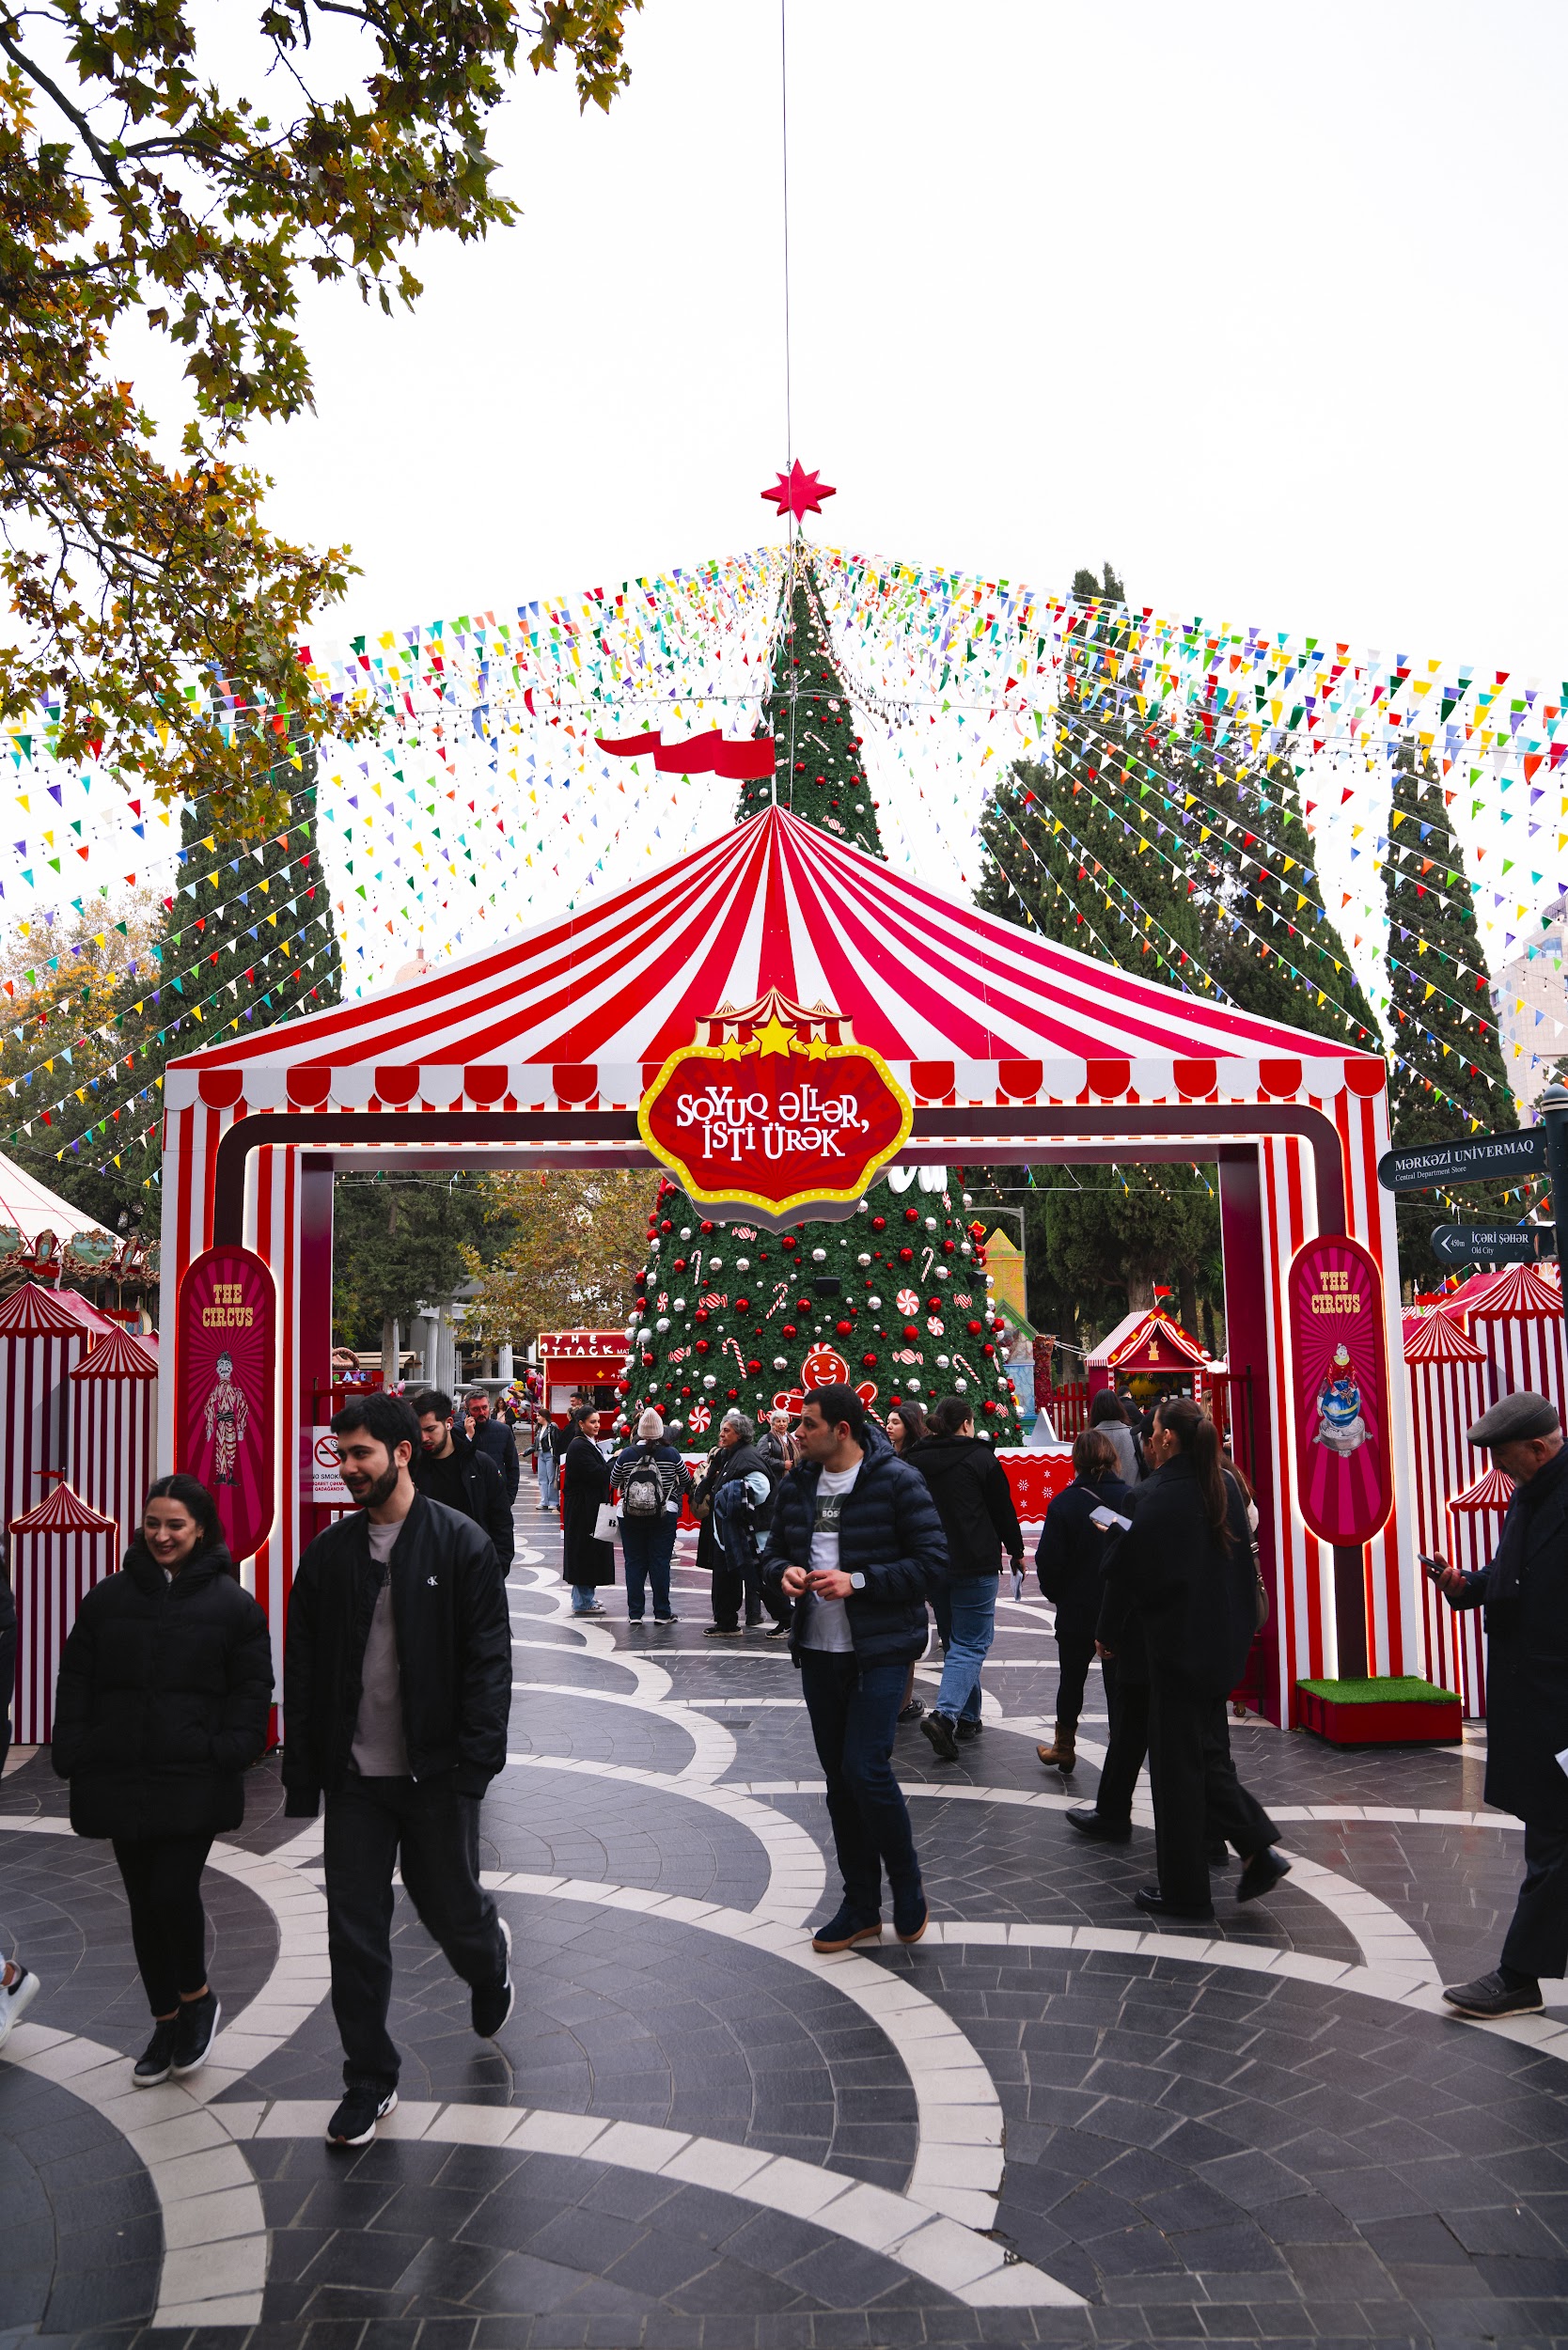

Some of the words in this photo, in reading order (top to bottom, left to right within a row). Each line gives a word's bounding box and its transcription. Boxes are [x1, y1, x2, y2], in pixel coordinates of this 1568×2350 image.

[677, 1086, 769, 1127] SOYUQ
[702, 1120, 756, 1162] İSTİ
[761, 1121, 846, 1160] ÜRƏK
[1395, 1151, 1450, 1171] MƏRKƏZİ
[1454, 1140, 1534, 1162] UNİVERMAQ
[1395, 1171, 1416, 1182] Central
[1417, 1167, 1450, 1179] Department
[1450, 1166, 1467, 1174] Store
[1450, 1239, 1466, 1247] 450m
[1471, 1230, 1497, 1246] İÇƏRİ
[1498, 1233, 1529, 1246] ŞƏHƏR
[1471, 1246, 1482, 1255] Old
[1482, 1246, 1495, 1256] City
[1320, 1271, 1348, 1292] THE
[213, 1284, 242, 1304] THE
[1311, 1294, 1360, 1314] CIRCUS
[202, 1308, 253, 1327] CIRCUS
[555, 1335, 597, 1344] THE
[540, 1342, 614, 1356] ATTACK
[342, 1371, 367, 1382] Art
